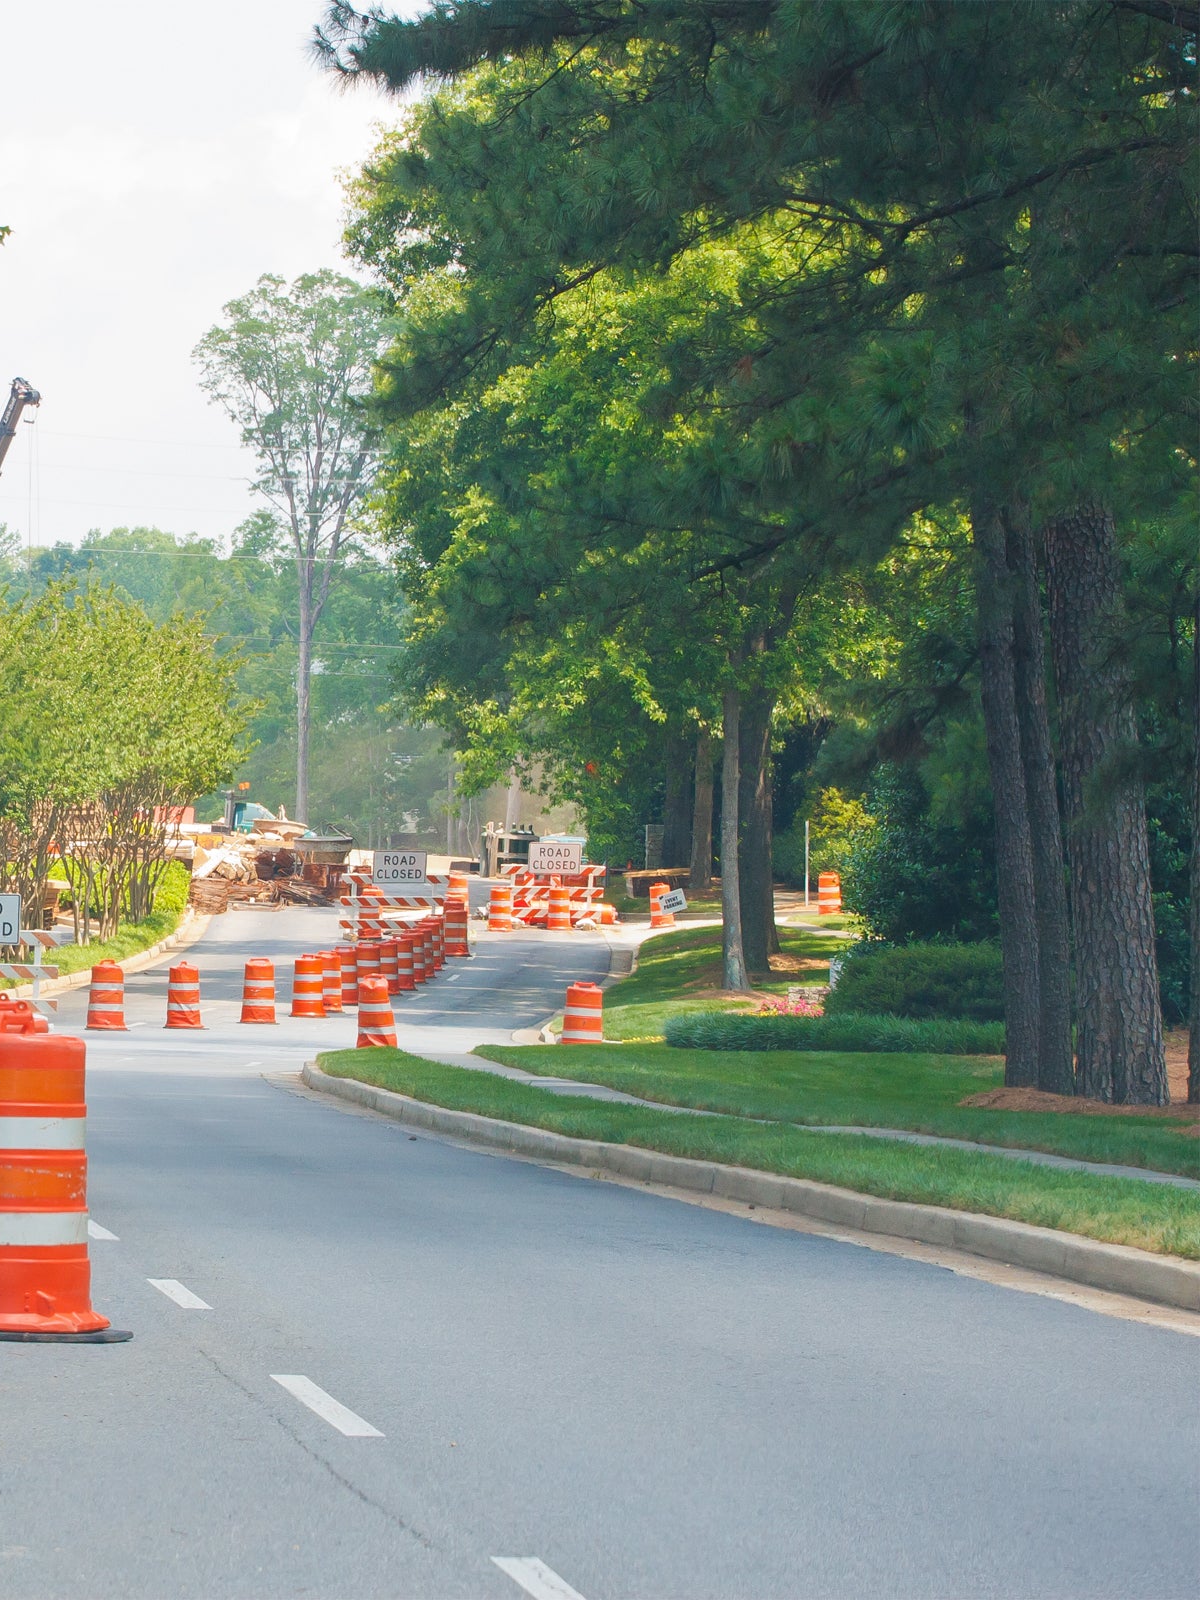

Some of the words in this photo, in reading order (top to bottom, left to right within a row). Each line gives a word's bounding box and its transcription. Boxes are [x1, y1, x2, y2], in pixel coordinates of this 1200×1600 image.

[539, 847, 571, 858] ROAD
[384, 855, 416, 866] ROAD
[532, 860, 576, 870] CLOSED
[376, 869, 422, 879] CLOSED
